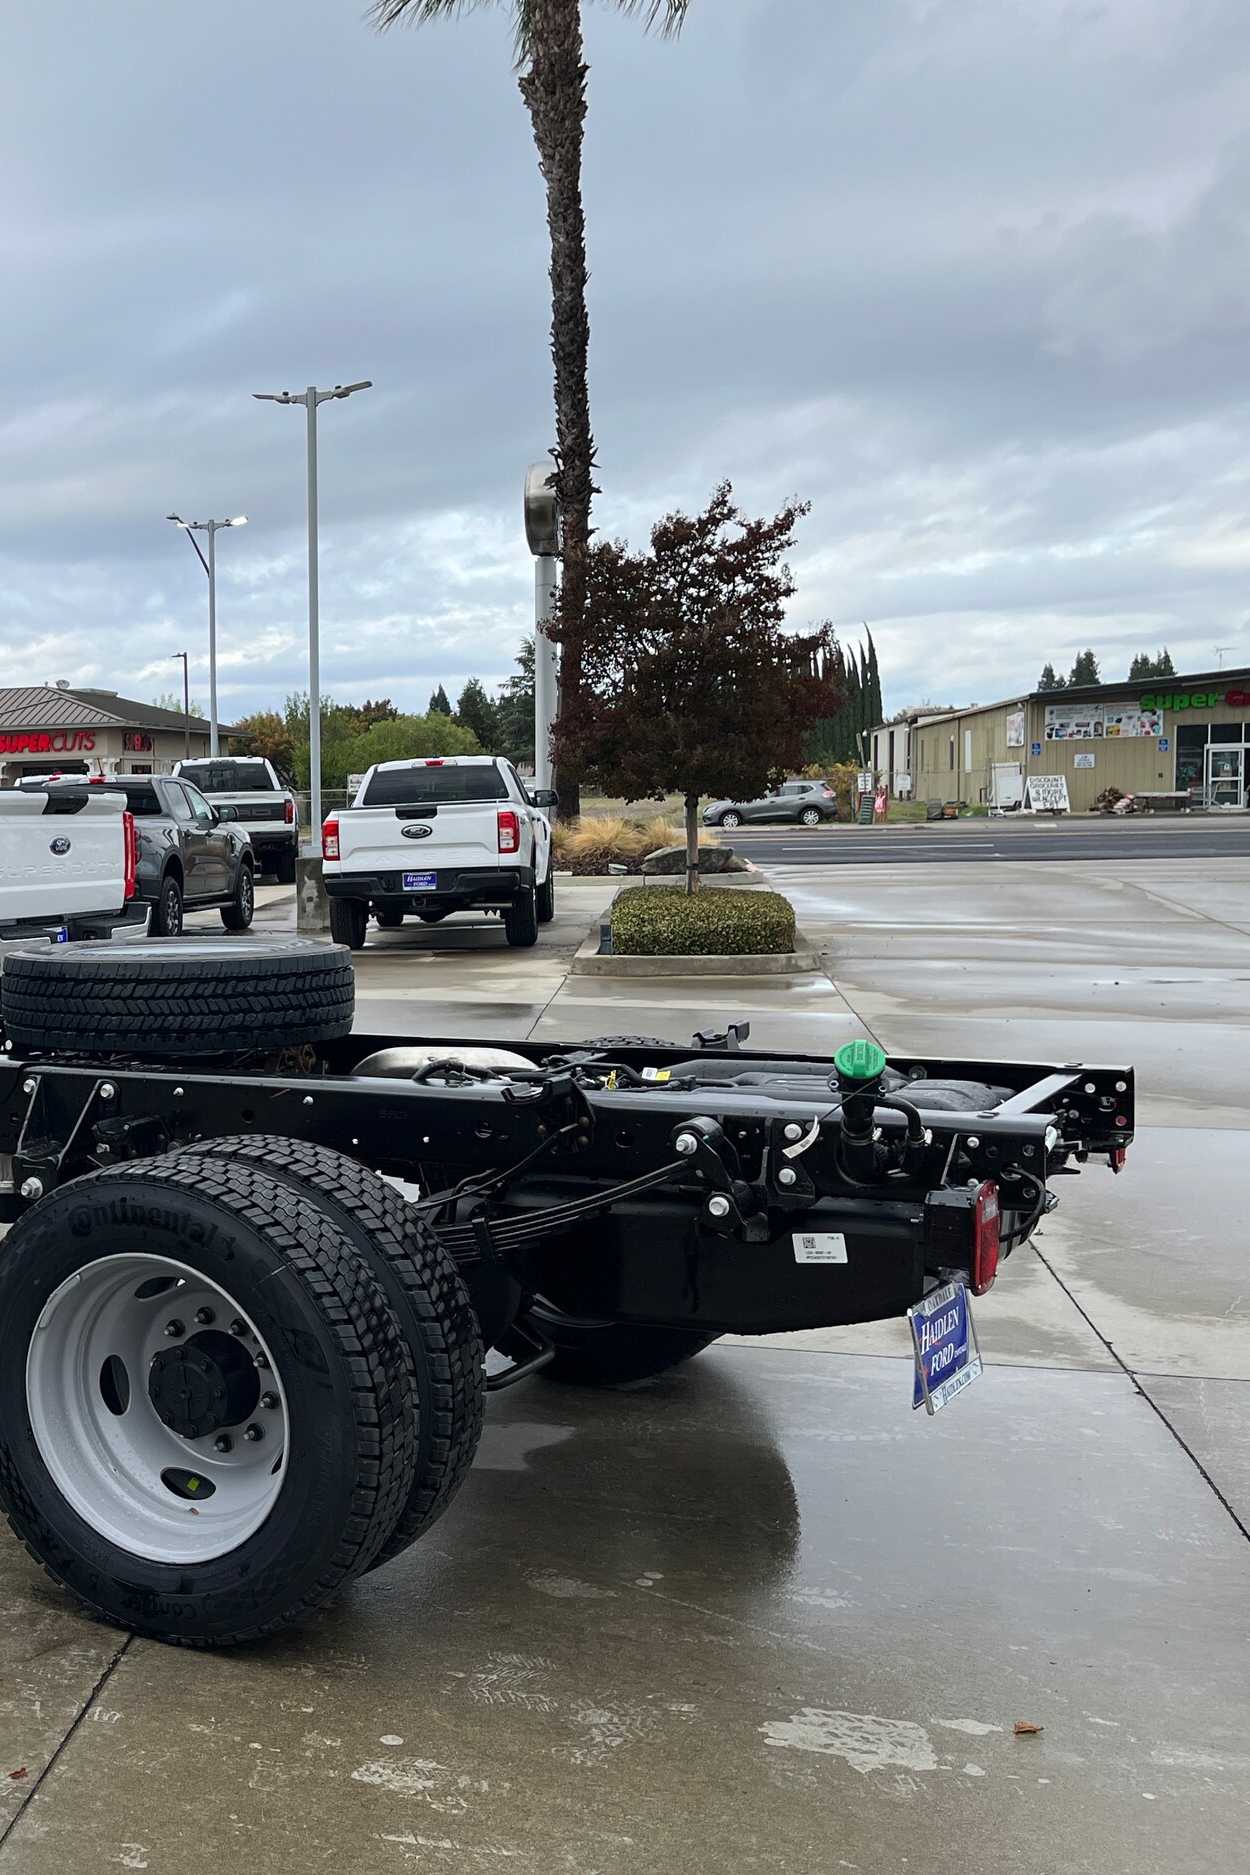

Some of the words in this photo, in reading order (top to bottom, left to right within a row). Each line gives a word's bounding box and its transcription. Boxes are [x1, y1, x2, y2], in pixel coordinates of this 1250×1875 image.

[1140, 692, 1218, 712] Super
[71, 861, 119, 875] DUTY
[920, 1306, 959, 1355] HAIDLEN
[931, 1342, 954, 1377] FORD
